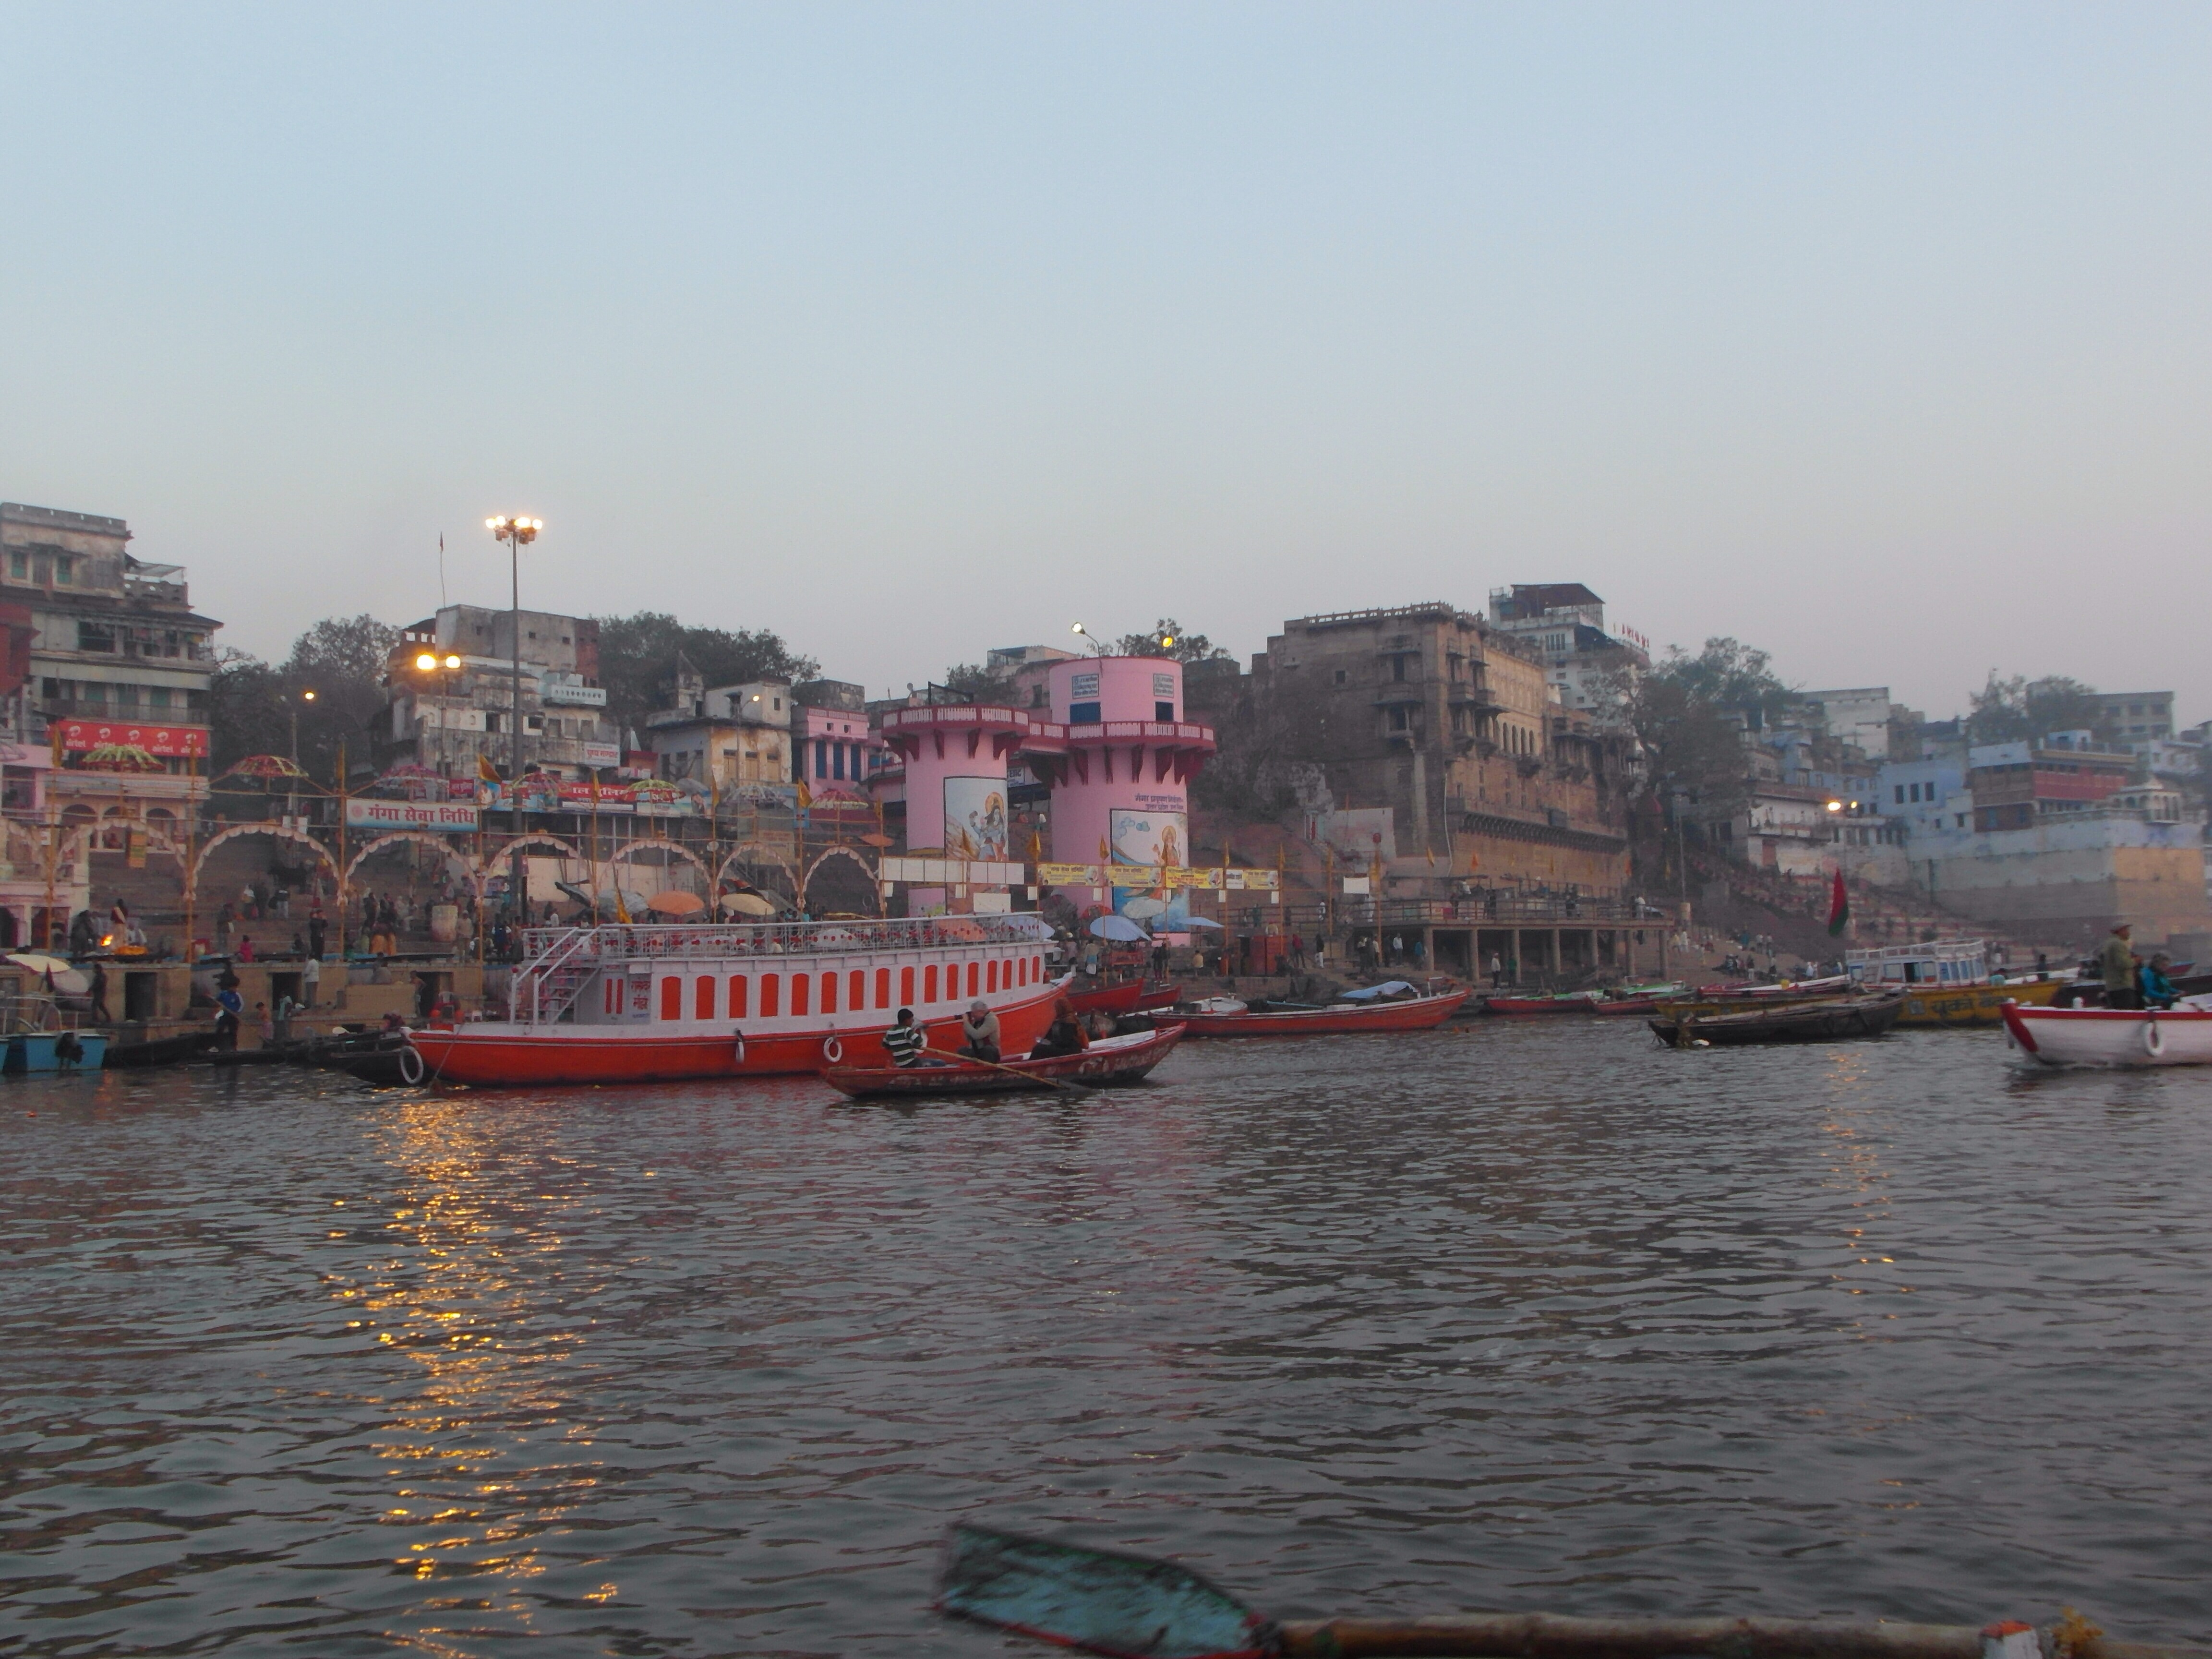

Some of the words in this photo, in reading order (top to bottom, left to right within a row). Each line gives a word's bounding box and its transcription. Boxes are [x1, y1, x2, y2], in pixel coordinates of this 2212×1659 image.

[369, 804, 400, 821] गंगा
[404, 806, 435, 822] सेवा
[439, 807, 475, 823] निधि
